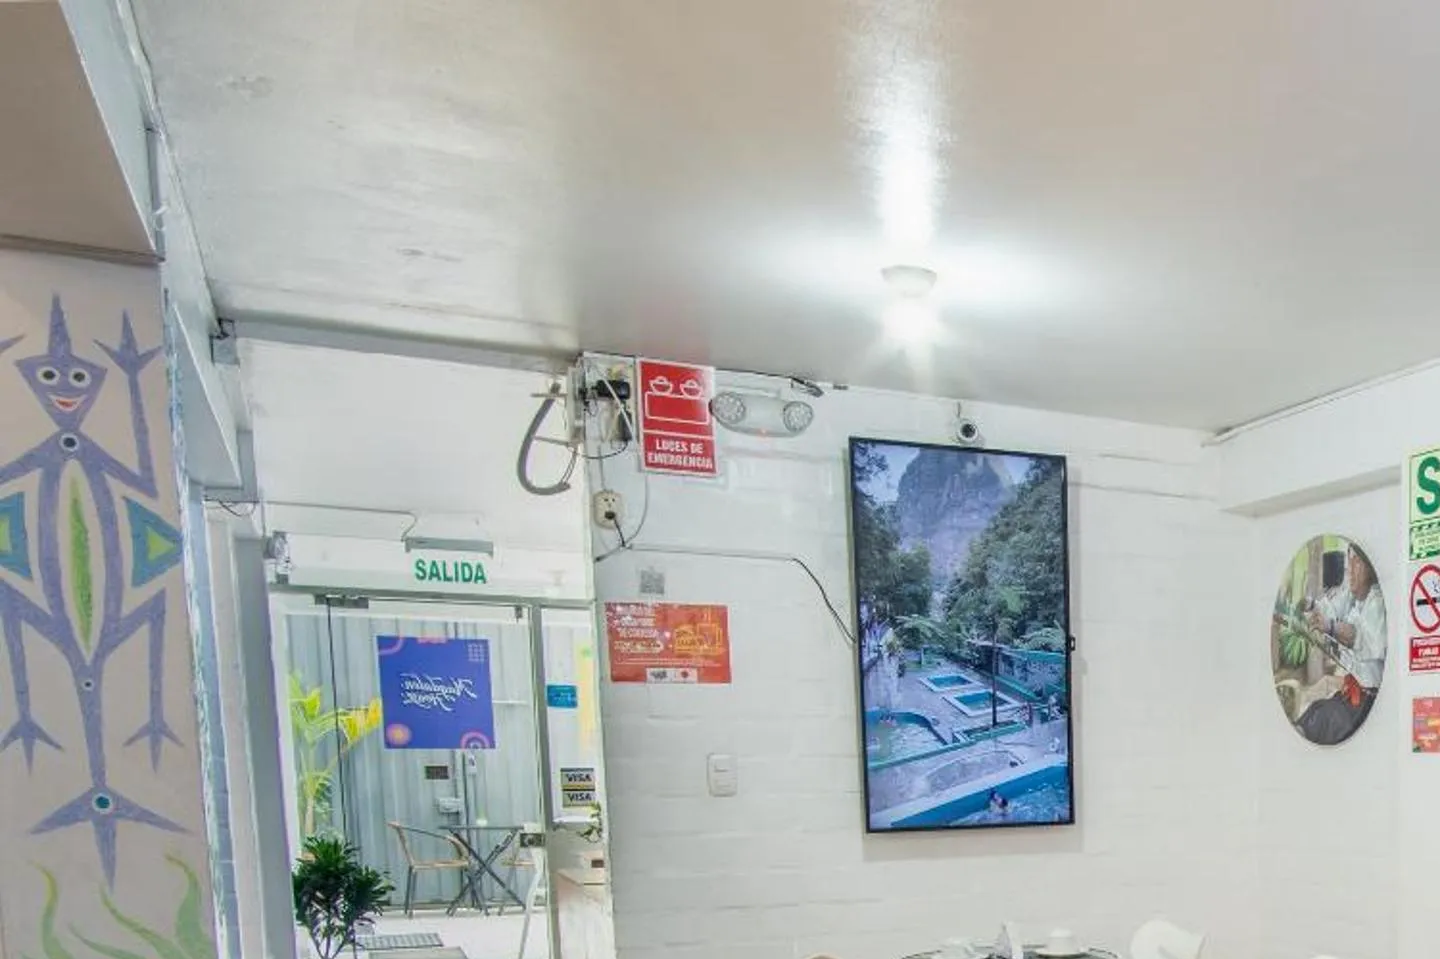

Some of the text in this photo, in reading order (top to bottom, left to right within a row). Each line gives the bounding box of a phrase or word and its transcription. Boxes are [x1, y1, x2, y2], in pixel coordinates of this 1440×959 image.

[655, 438, 704, 454] LUCES DE
[647, 452, 713, 470] EMERGENCIA
[414, 558, 487, 584] SALIDA
[566, 773, 592, 782] VISA
[567, 792, 592, 802] VISA
